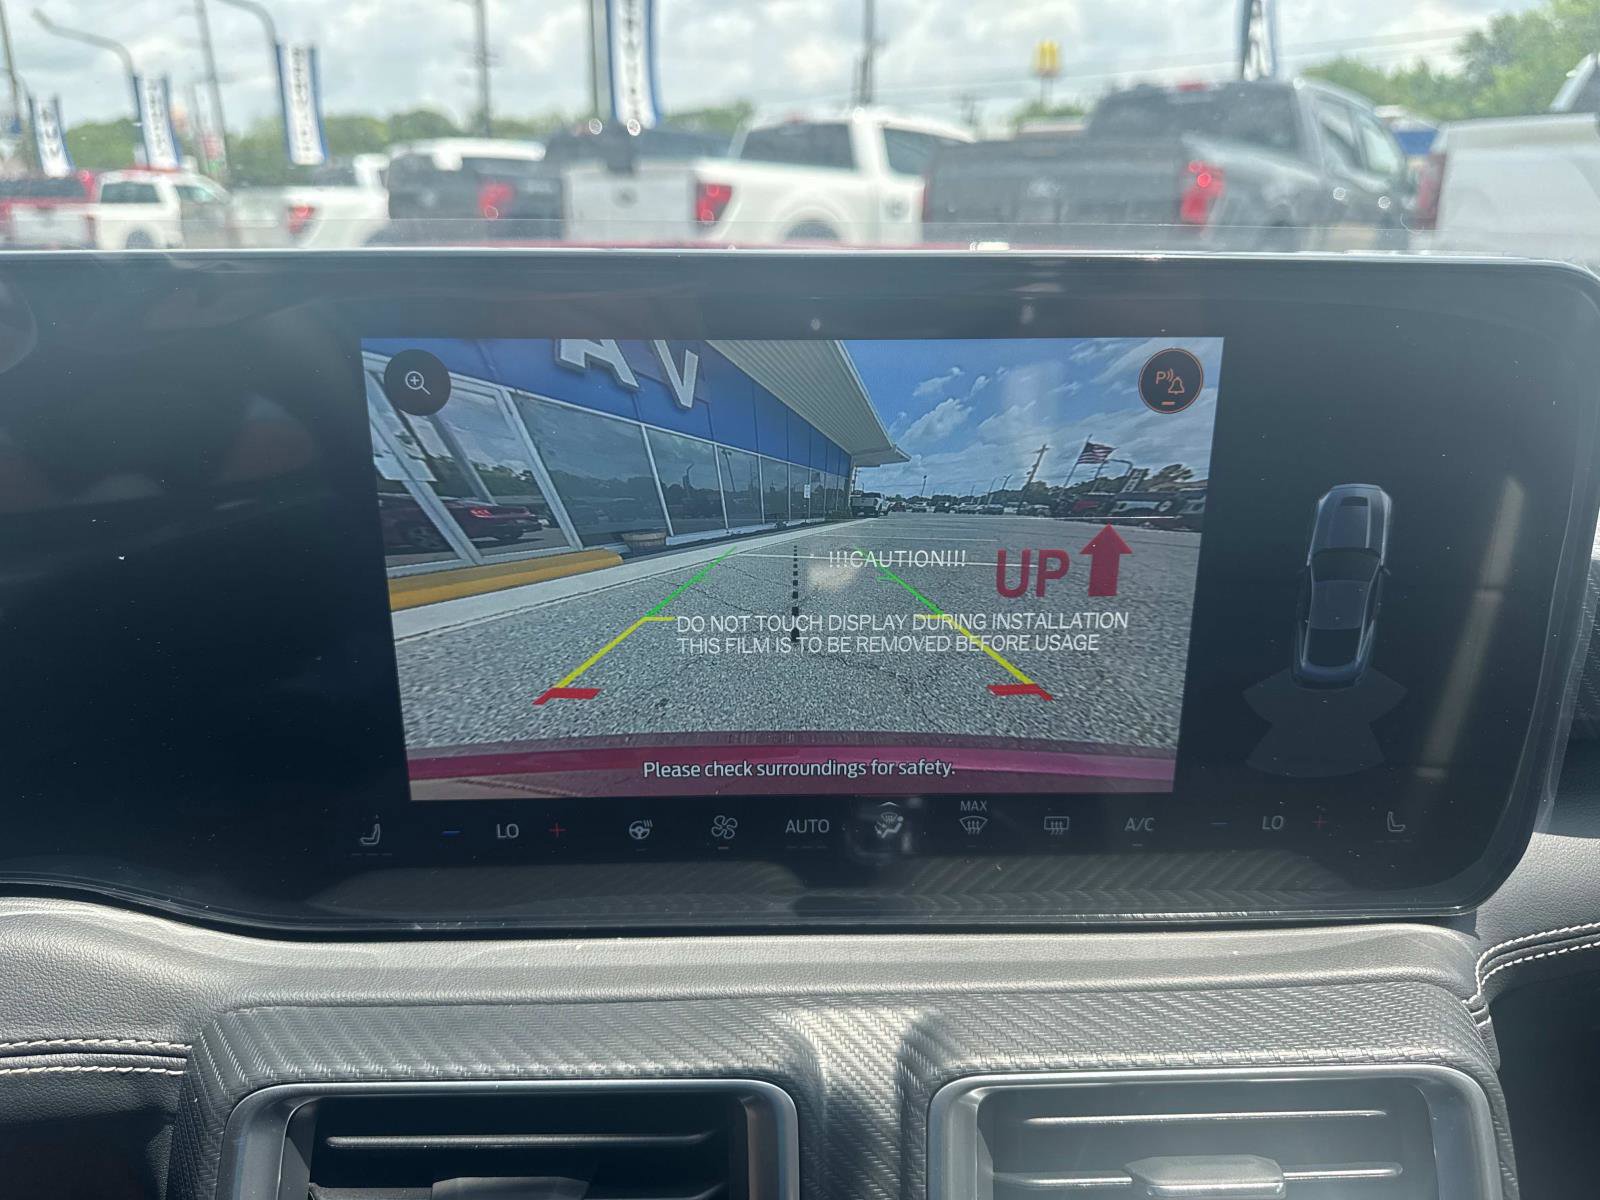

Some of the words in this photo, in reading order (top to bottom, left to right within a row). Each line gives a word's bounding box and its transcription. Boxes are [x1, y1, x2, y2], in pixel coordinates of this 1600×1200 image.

[829, 549, 967, 568] !!!CAUTION!!!
[996, 548, 1071, 598] UP
[677, 615, 705, 633] DO
[710, 615, 750, 633] NOT
[754, 614, 823, 632] TOUCH
[828, 613, 908, 631] DISPLAY
[912, 613, 987, 630] DURING
[992, 611, 1129, 630] INSTALLATION
[677, 637, 721, 654] THIS
[725, 637, 770, 653] FILM
[775, 636, 792, 653] IS
[796, 636, 823, 653] TO
[827, 636, 852, 653] BE
[856, 635, 951, 652] REMOVED
[955, 634, 1031, 652] BEFORE
[1034, 633, 1100, 651] USAGE
[643, 761, 701, 778] Please
[704, 760, 753, 777] check
[756, 759, 867, 778] surroundings
[871, 758, 895, 775] for
[898, 758, 956, 778] safety.
[960, 800, 987, 812] MAX
[496, 823, 519, 838] LO
[785, 818, 830, 833] AUTO
[1124, 816, 1155, 832] A/C
[1261, 815, 1284, 831] LO
